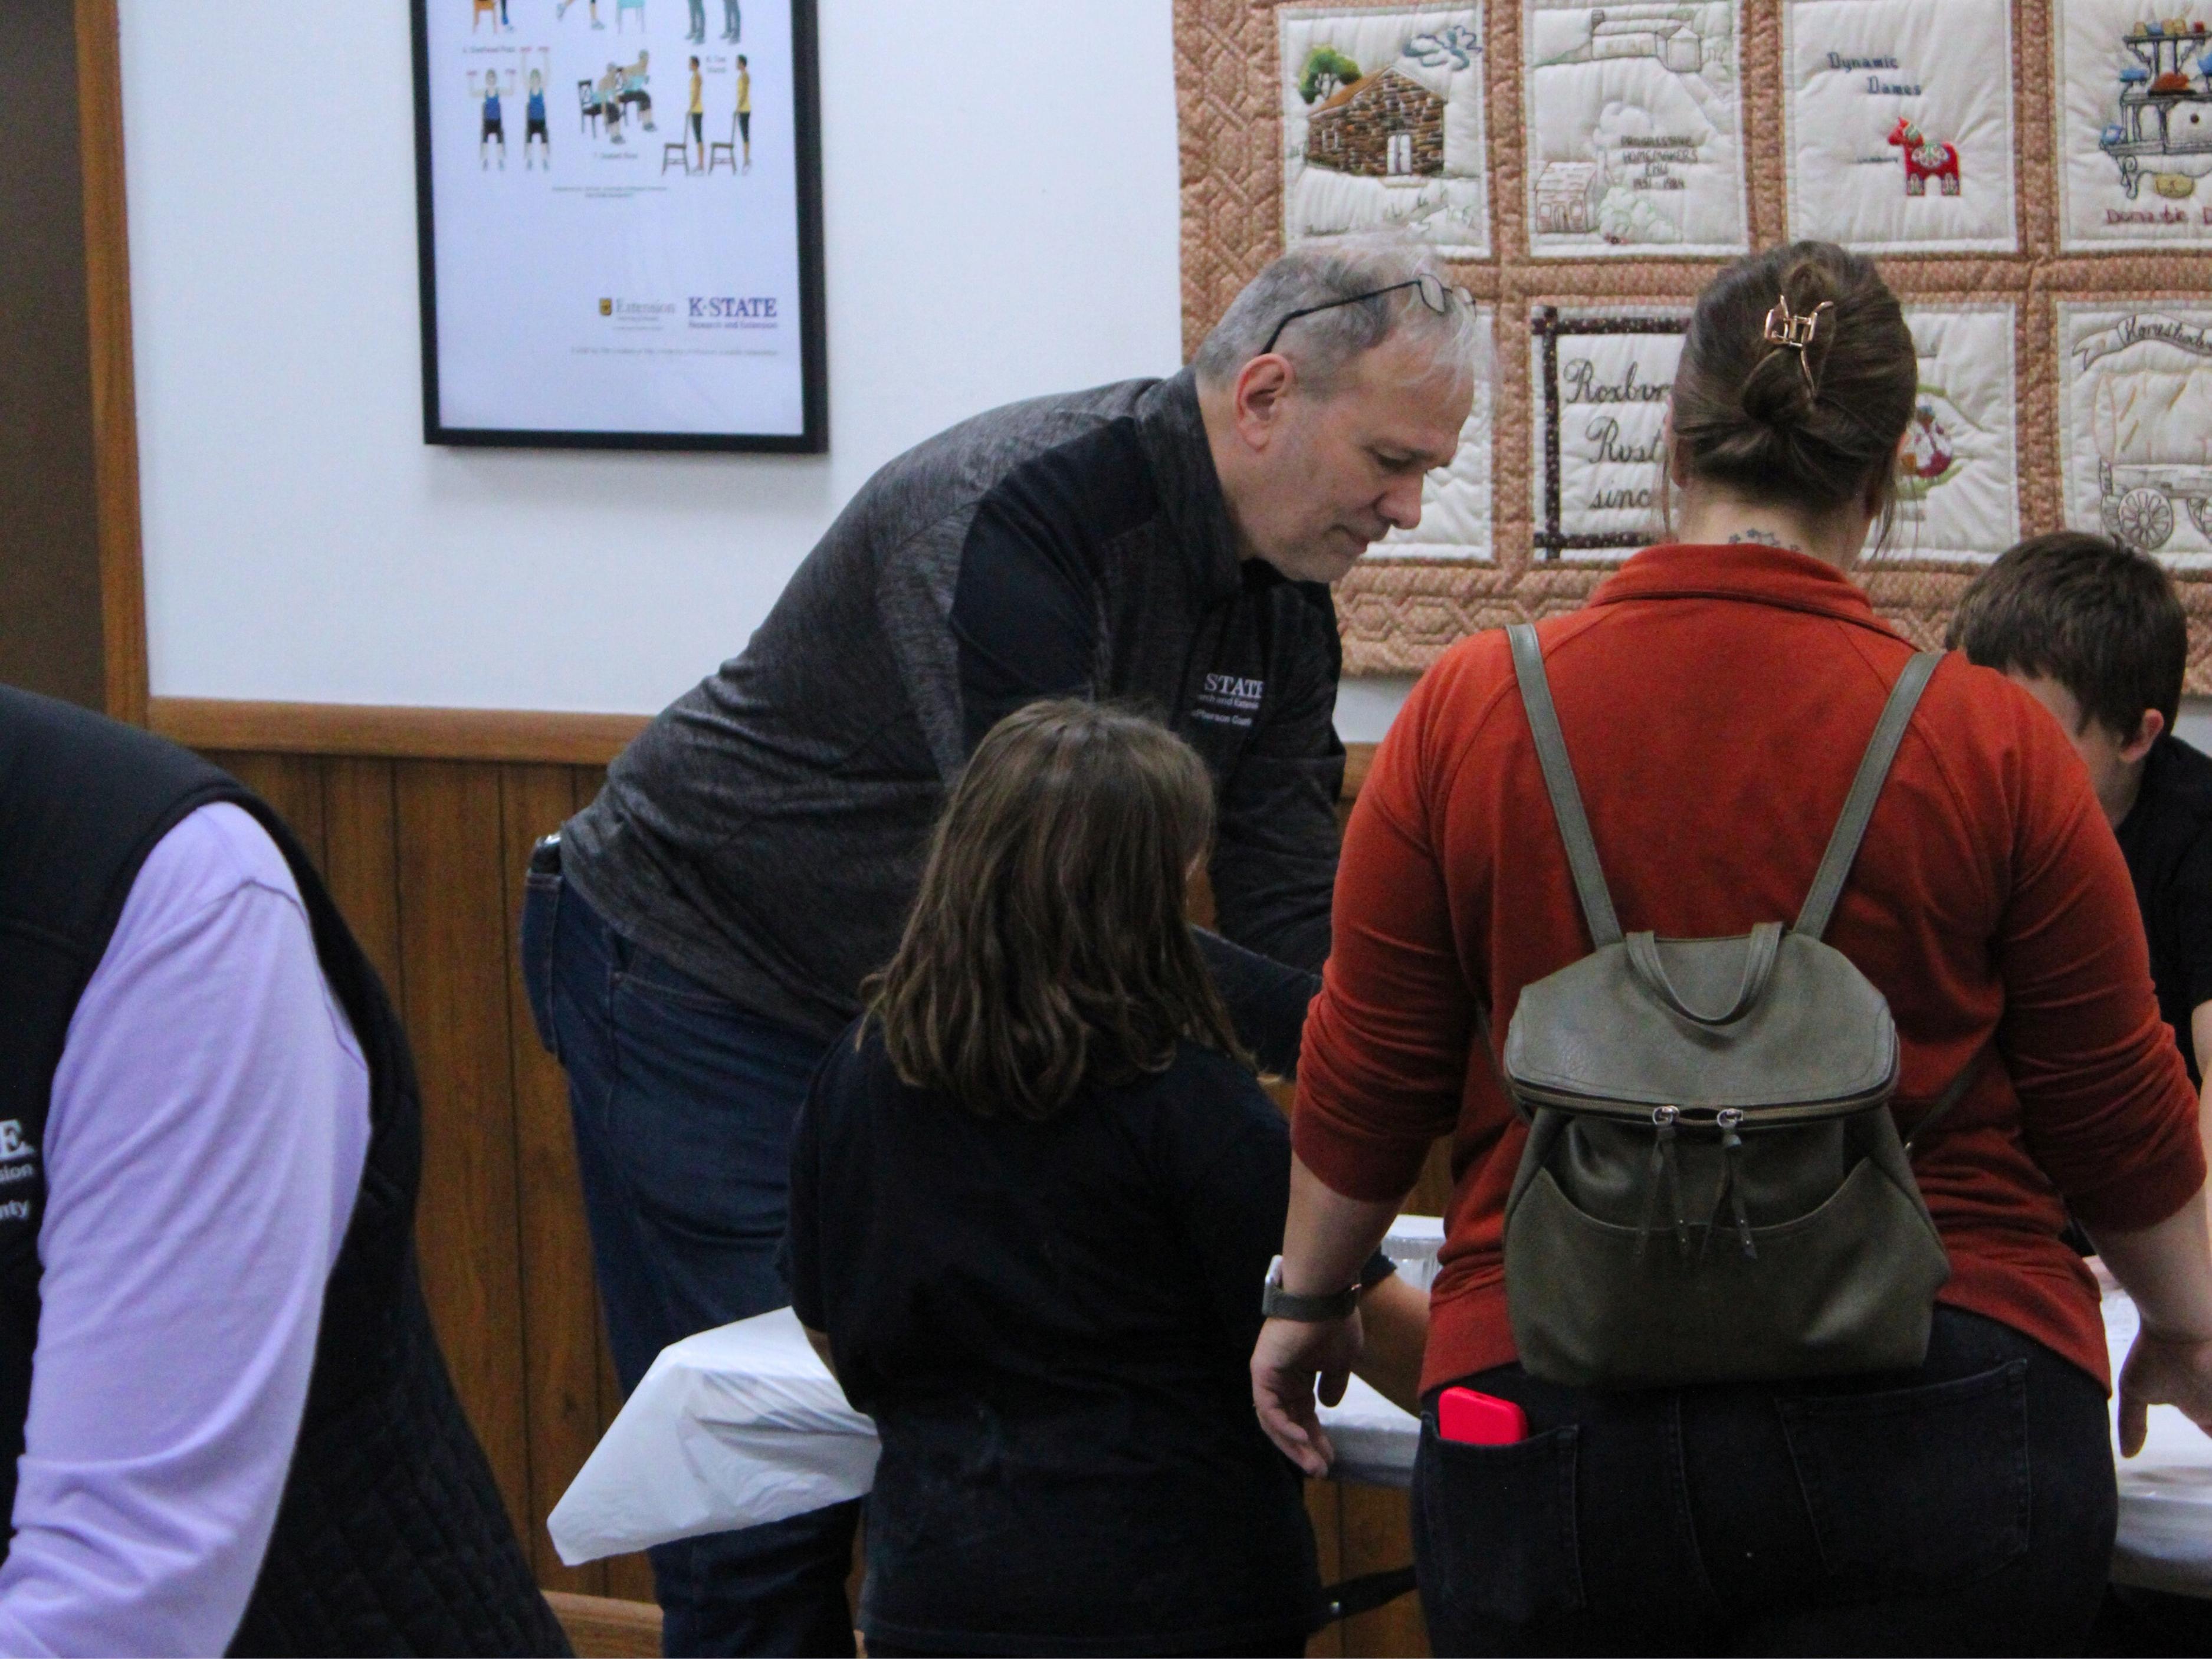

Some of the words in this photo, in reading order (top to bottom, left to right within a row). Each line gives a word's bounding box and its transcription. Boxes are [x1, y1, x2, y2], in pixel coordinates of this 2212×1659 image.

[1827, 51, 1899, 73] Dynamic
[1868, 75, 1921, 96] Dames
[1563, 358, 1670, 403] Roxbur
[1586, 416, 1665, 464] Rust
[1588, 480, 1653, 509] sinc
